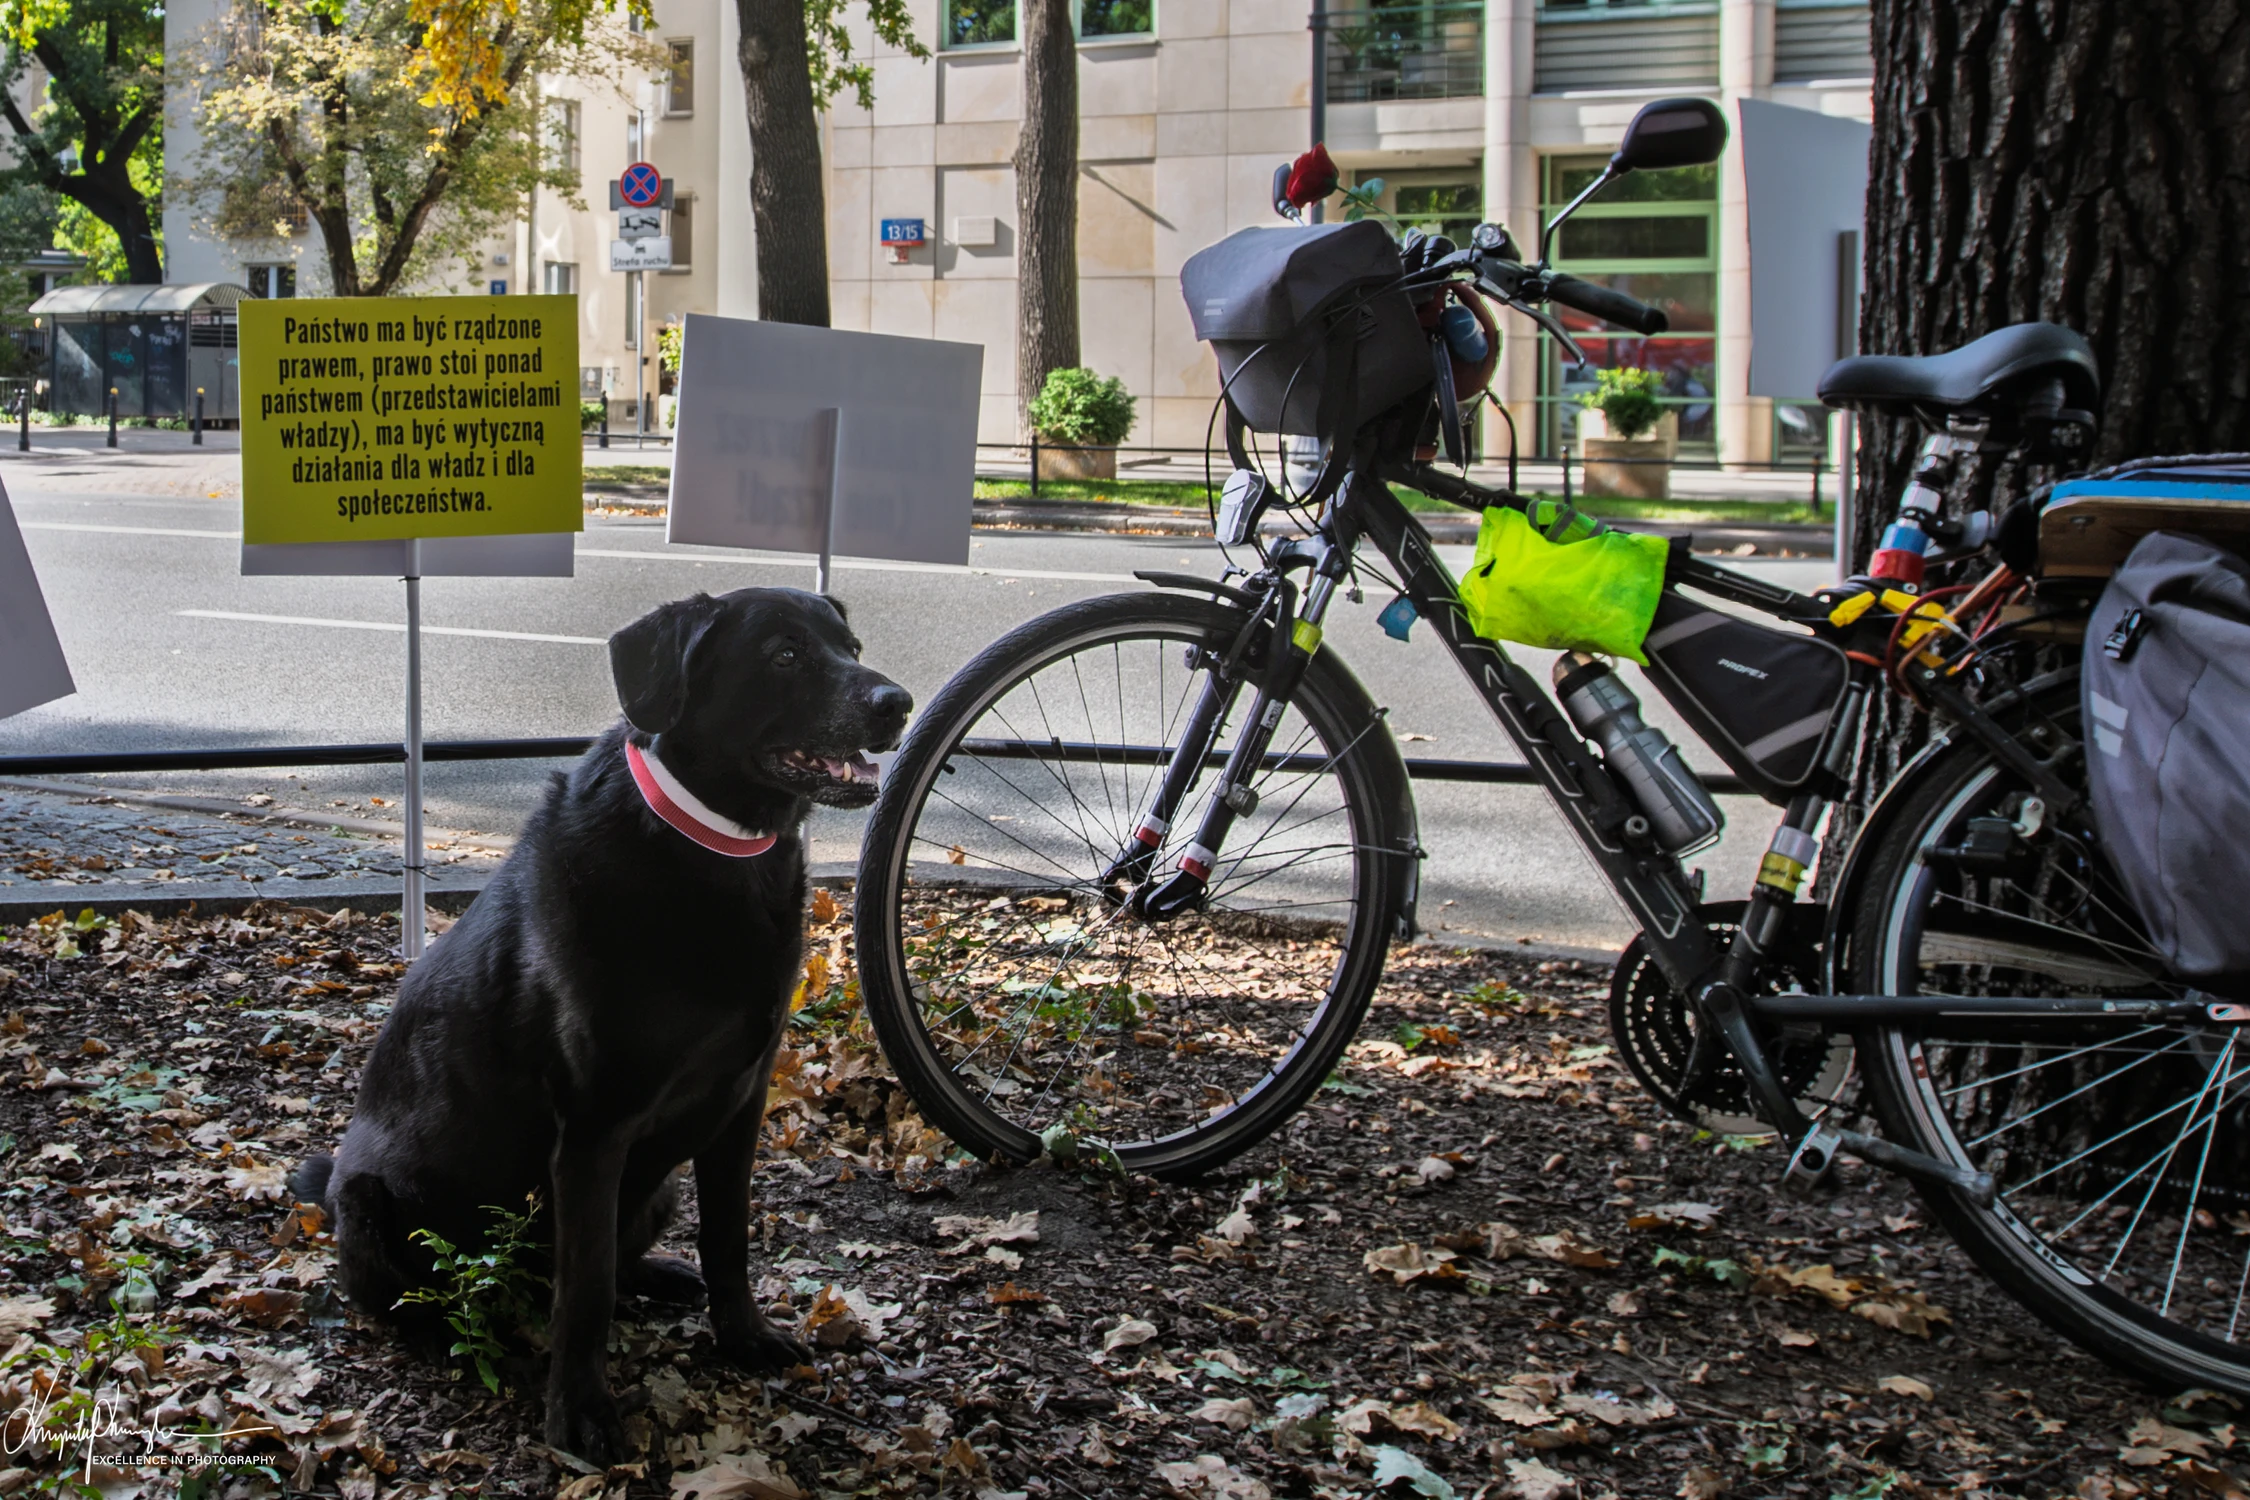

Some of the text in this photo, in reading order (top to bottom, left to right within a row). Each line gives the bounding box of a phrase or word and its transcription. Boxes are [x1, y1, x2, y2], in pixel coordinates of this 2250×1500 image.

[887, 225, 918, 240] 13/15
[613, 256, 669, 267] Strefa ruchu
[284, 313, 542, 347] Państwo ma być rządzone
[278, 346, 542, 385] prawem, prawo stoi ponad
[261, 380, 561, 419] państwem (przedstawicielami
[280, 418, 545, 453] władzy), ma być wytyczną
[292, 450, 535, 483] działania dla władz i dla
[337, 487, 492, 522] społeczeństwa.
